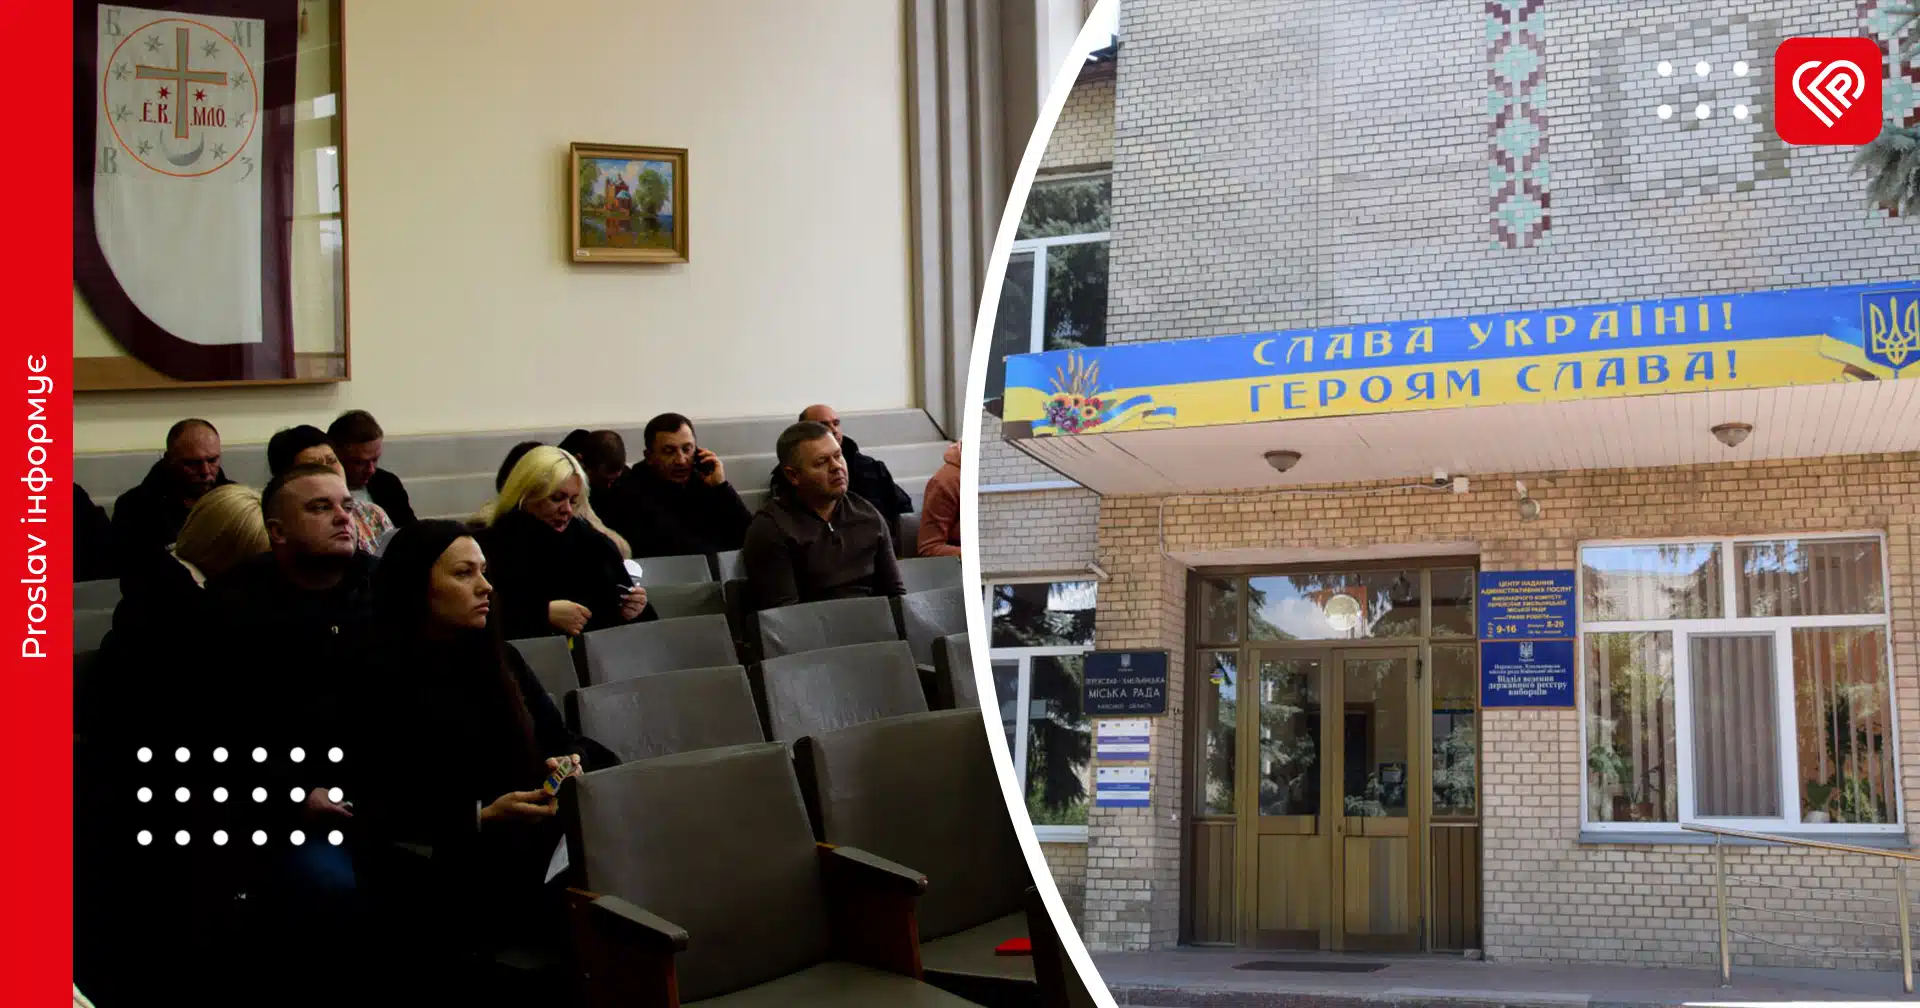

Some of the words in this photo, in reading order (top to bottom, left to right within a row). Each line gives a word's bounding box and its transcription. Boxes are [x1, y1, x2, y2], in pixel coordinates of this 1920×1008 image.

[1252, 326, 1434, 366] СЛАВА
[1468, 302, 1733, 350] УКРАЇНІ!
[1250, 368, 1481, 412] ГЕРОЯМ
[1516, 350, 1737, 392] СЛАВА!
[1496, 624, 1517, 634] 9-16
[1088, 688, 1127, 699] МІСЬКА
[1132, 687, 1161, 698] РАДА
